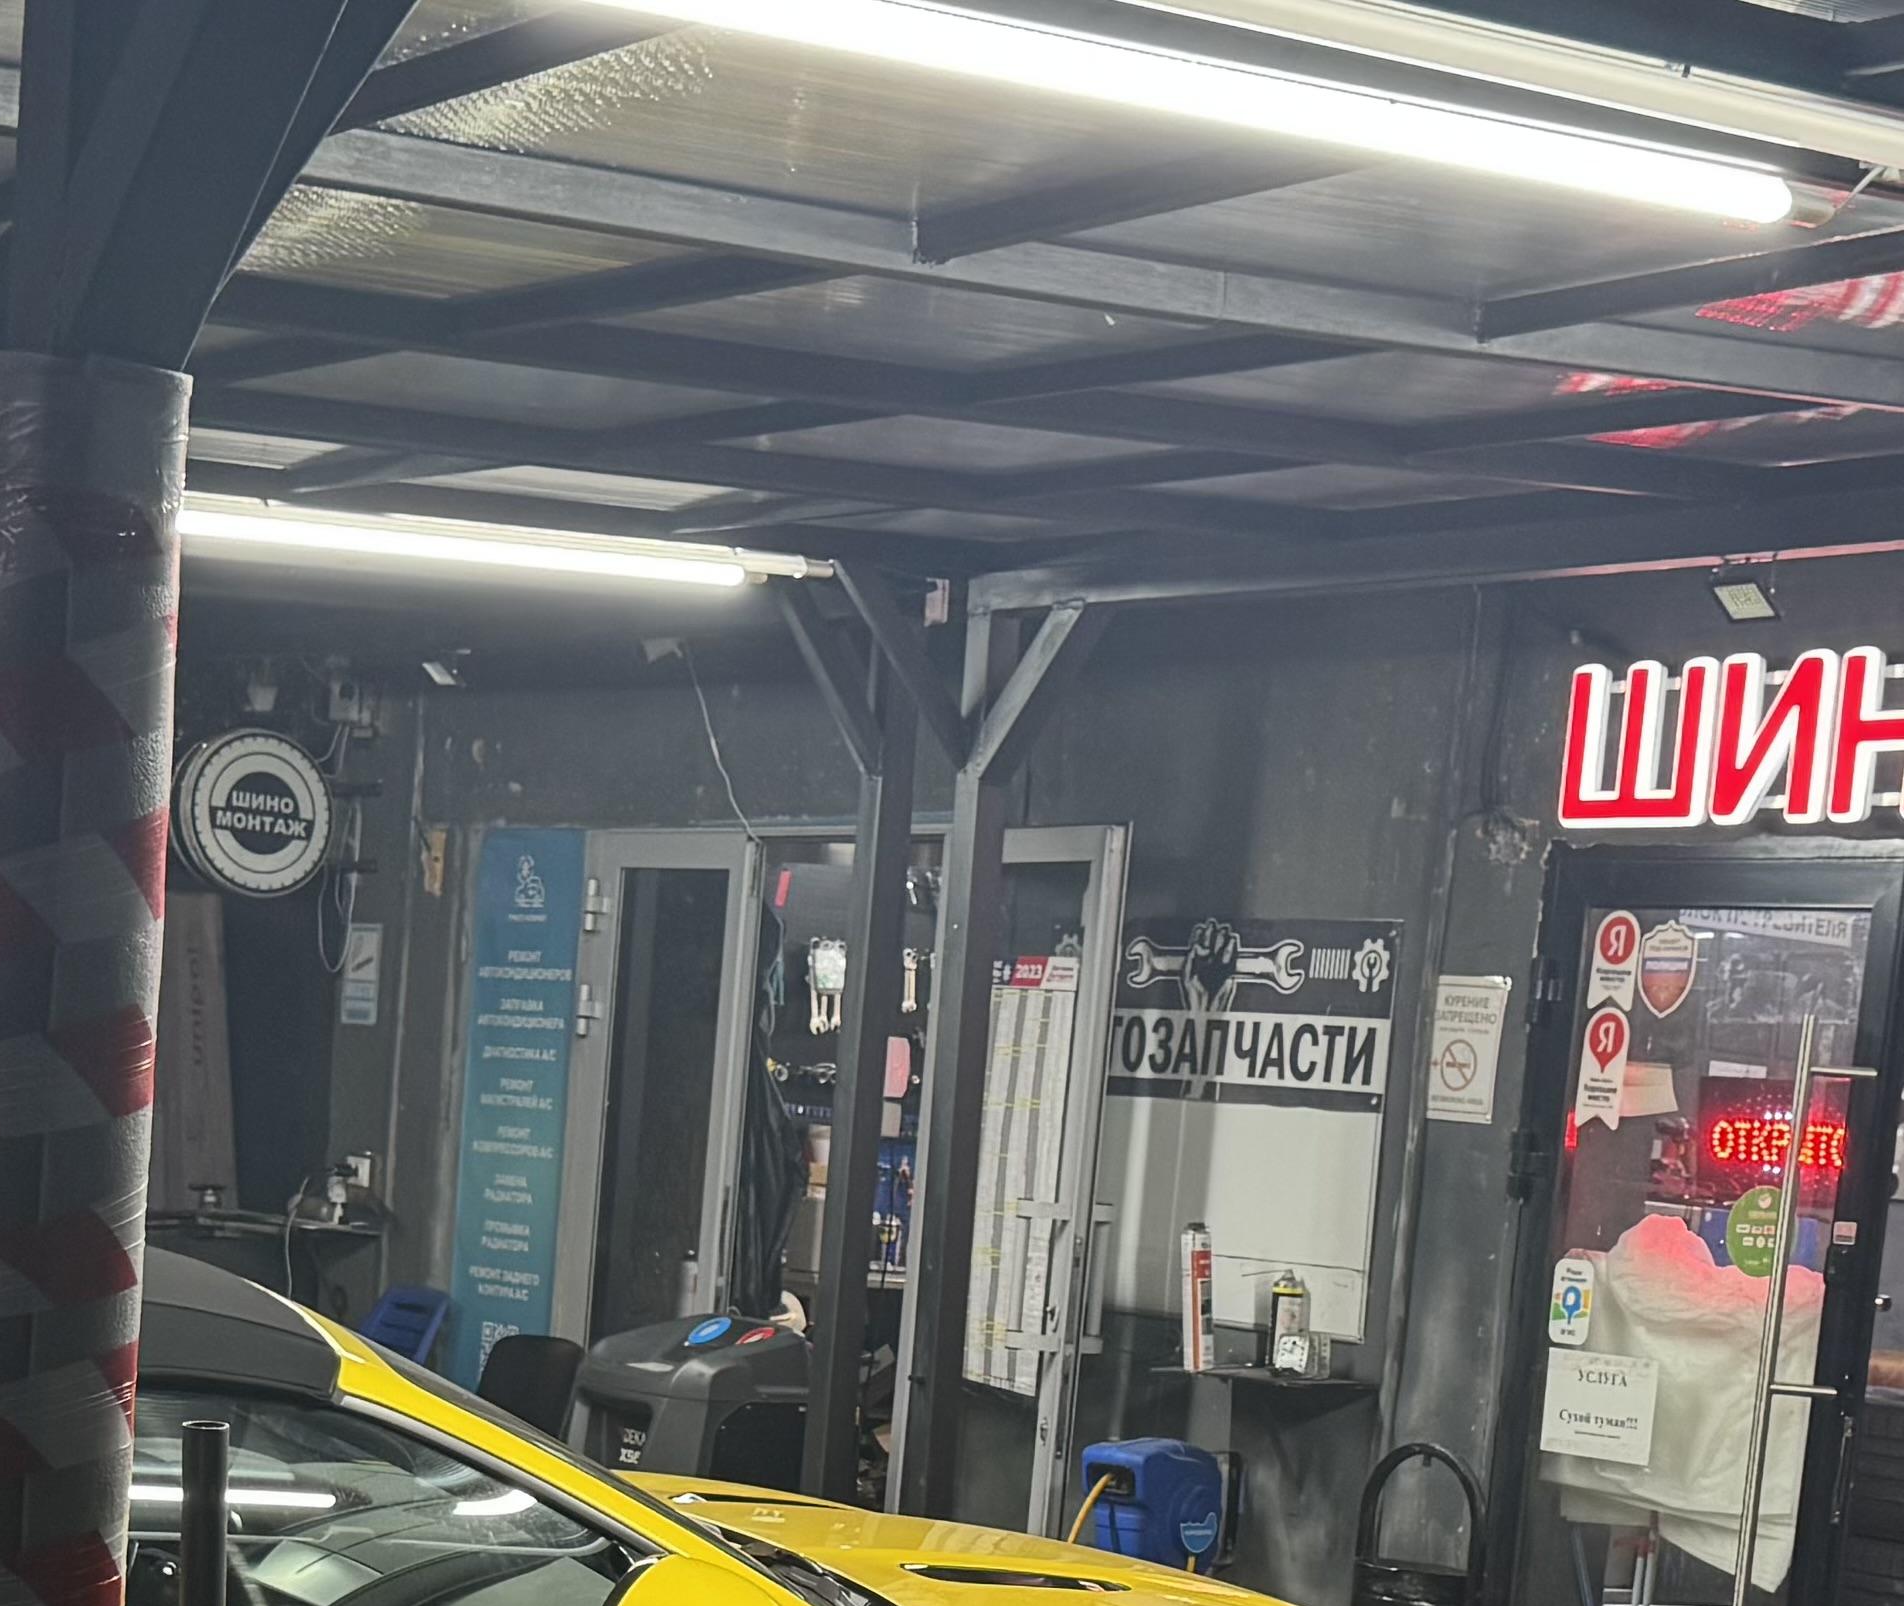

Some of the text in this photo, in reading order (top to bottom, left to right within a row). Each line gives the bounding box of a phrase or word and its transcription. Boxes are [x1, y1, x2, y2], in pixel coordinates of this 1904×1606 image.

[231, 790, 295, 815] ШИНО
[216, 810, 308, 838] МОНТАЖ
[1608, 925, 1627, 957] Я
[1597, 1020, 1616, 1053] Я
[1577, 1368, 1627, 1387] УСЛУГА
[1559, 1408, 1591, 1424] Сухой
